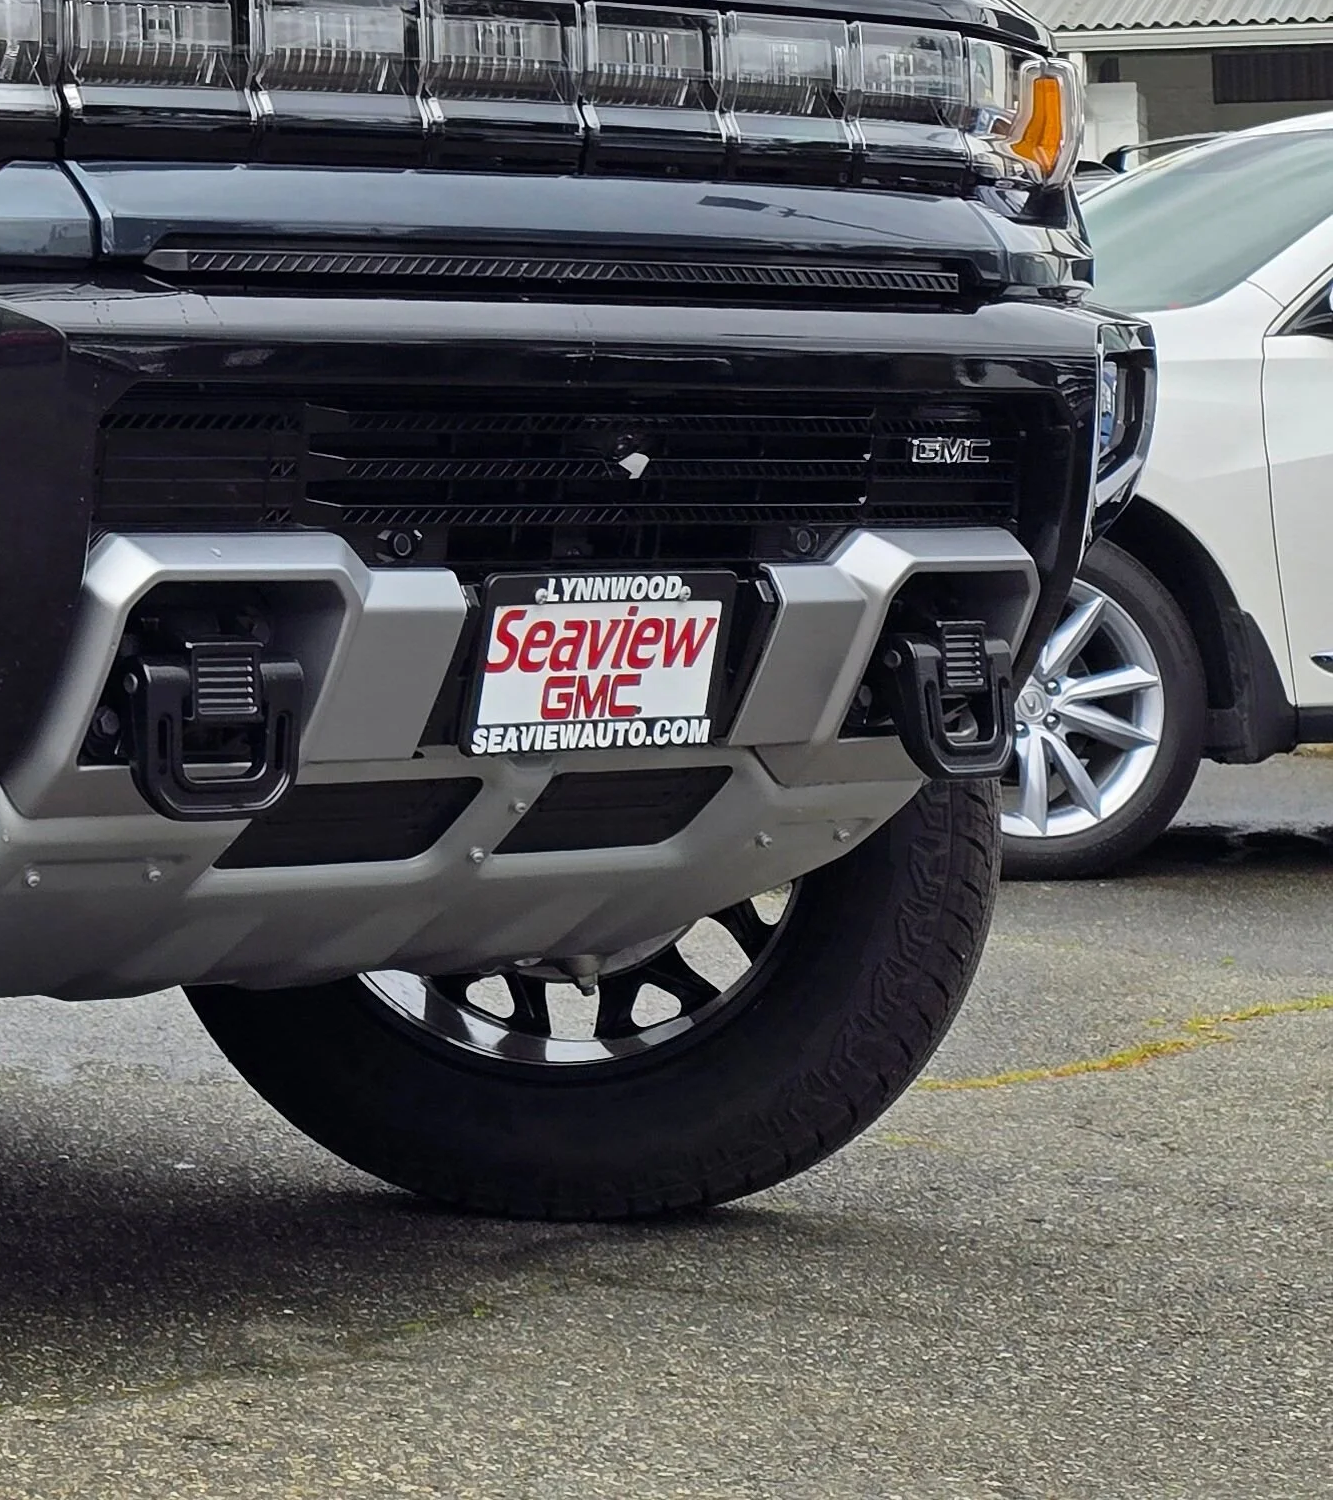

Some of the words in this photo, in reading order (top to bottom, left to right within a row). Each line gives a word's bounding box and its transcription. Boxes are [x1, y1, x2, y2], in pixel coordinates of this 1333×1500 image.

[912, 437, 991, 463] GMC
[546, 576, 682, 602] LYNNWOOD
[485, 606, 717, 673] Seaview
[540, 674, 642, 720] GMC
[471, 719, 711, 755] SEAVIEWAUTO.COM
